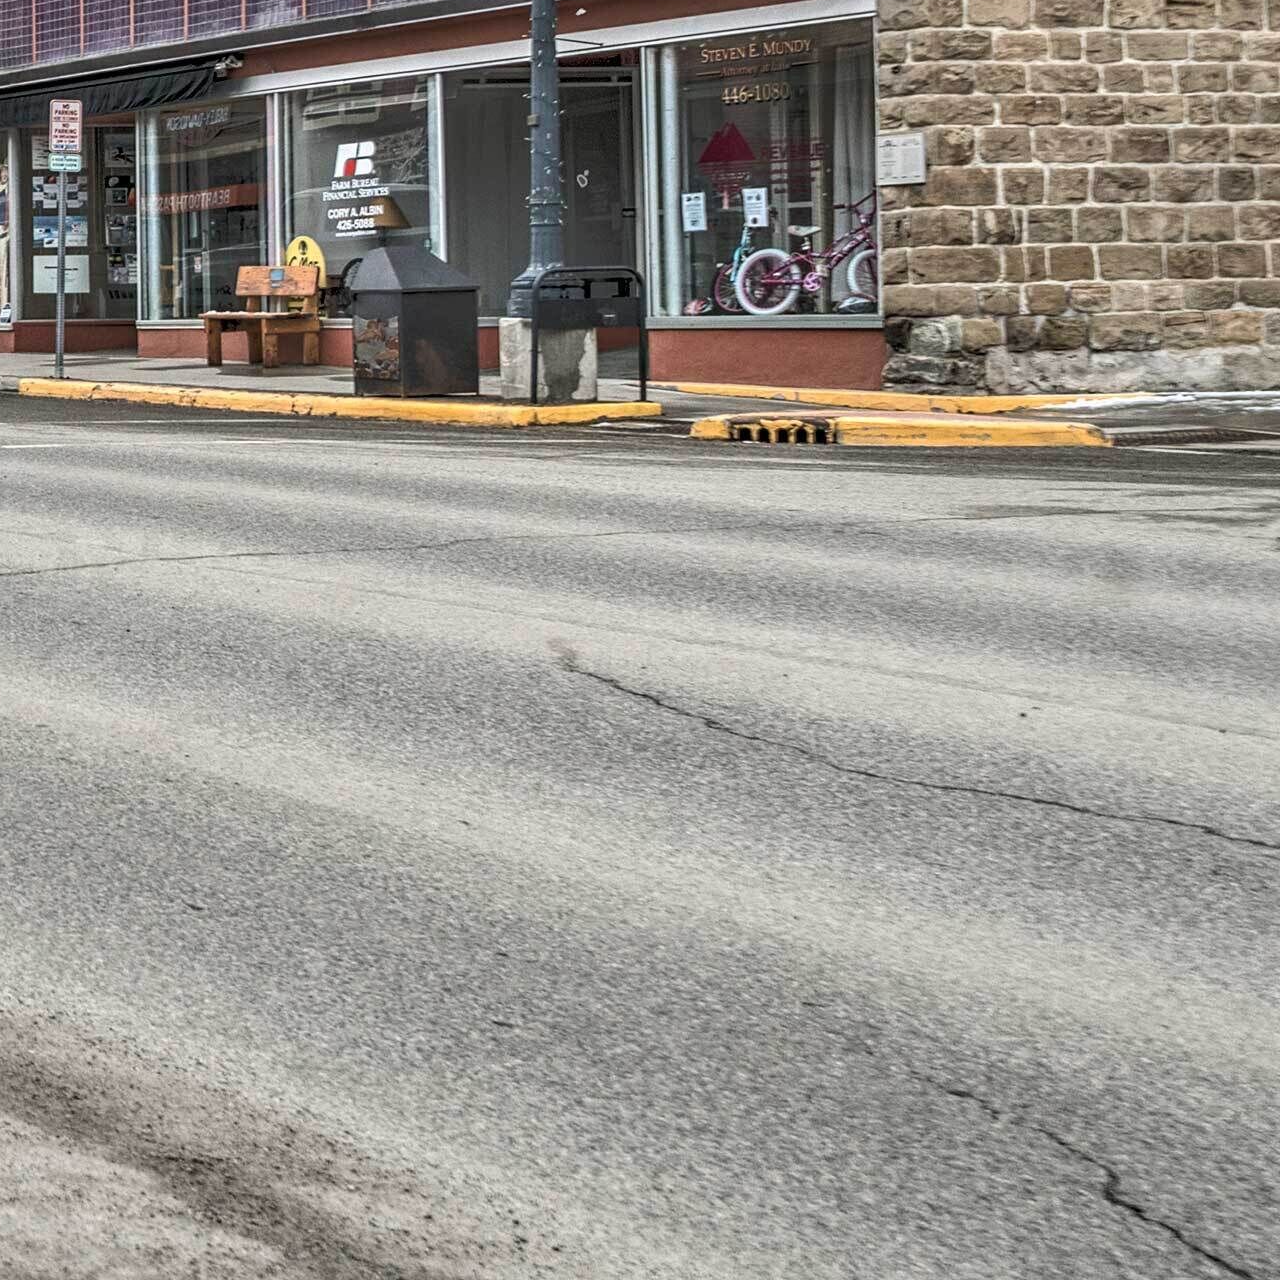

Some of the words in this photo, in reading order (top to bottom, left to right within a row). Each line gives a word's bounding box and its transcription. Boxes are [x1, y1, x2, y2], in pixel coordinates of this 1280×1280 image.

[701, 47, 746, 63] STEVEN
[763, 39, 812, 56] MUNDY
[331, 180, 351, 190] FARM
[352, 178, 379, 188] BUREAU
[322, 191, 357, 201] FINANCIAL
[359, 187, 390, 197] SERVICES
[328, 208, 349, 219] CORY
[360, 205, 384, 215] ALBIN
